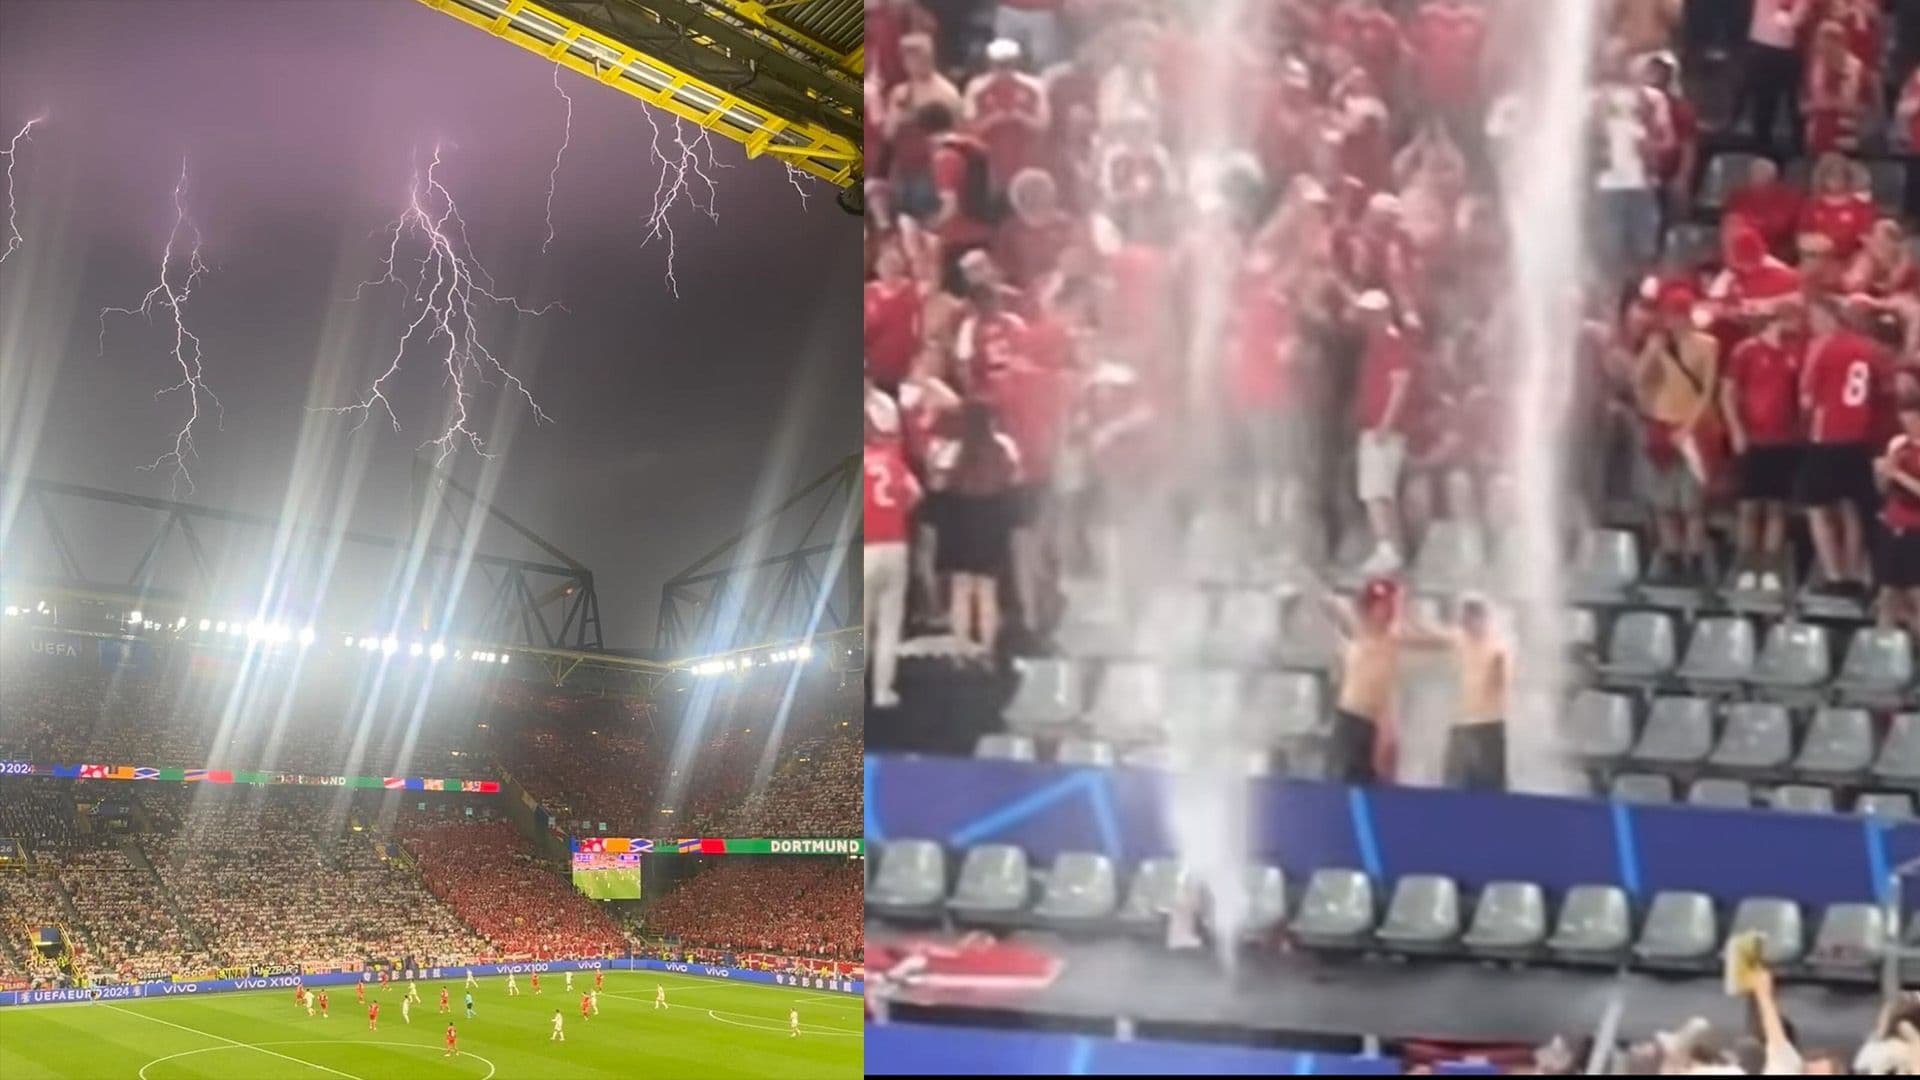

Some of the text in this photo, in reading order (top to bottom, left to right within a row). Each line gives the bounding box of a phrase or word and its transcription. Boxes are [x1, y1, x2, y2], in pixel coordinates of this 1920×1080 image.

[1842, 361, 1869, 407] 8
[867, 465, 895, 506] 2
[32, 640, 77, 656] UEFA
[276, 774, 346, 786] DORUND
[771, 840, 860, 853] DORTMUND
[523, 963, 549, 972] X100
[269, 976, 301, 987] X100
